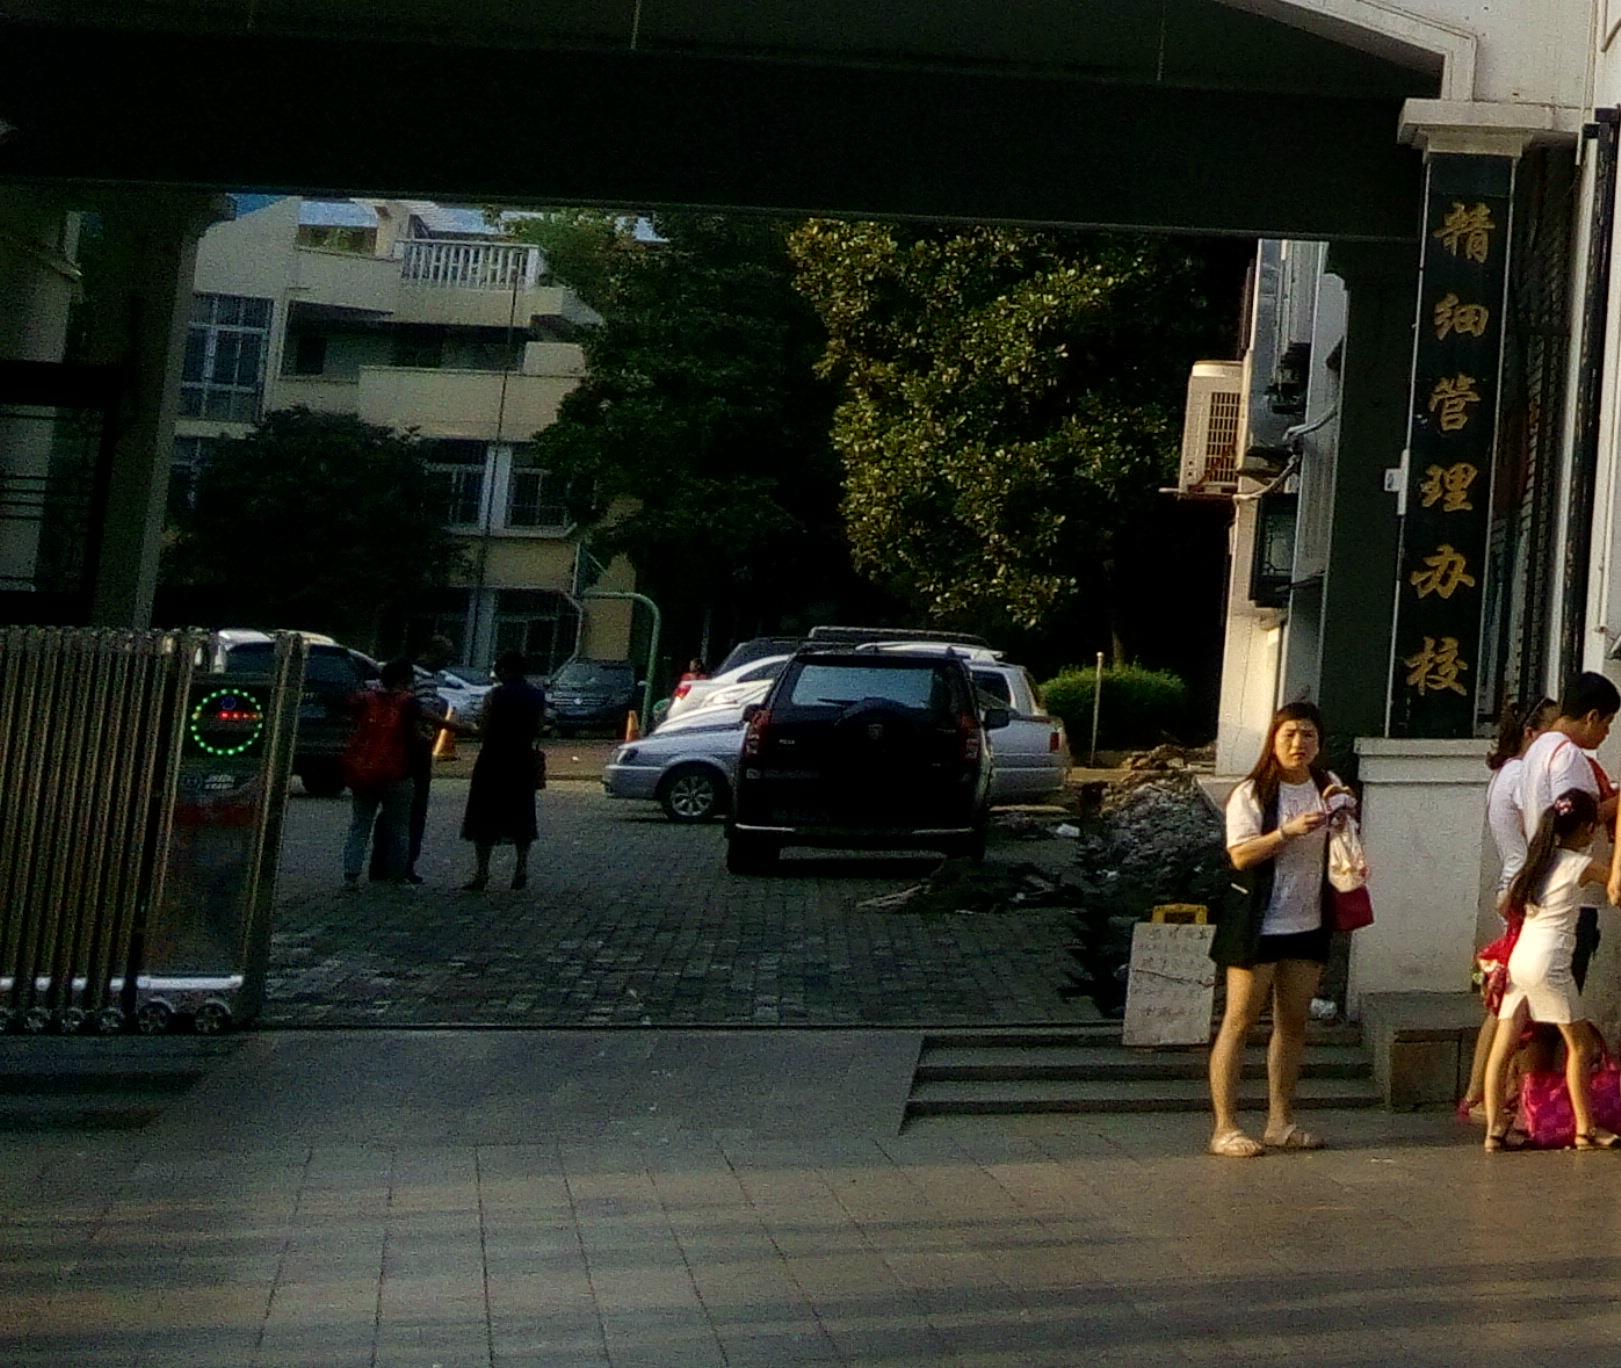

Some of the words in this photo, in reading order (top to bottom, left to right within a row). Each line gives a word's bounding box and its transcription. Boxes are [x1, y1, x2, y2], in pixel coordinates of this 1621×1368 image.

[1403, 201, 1497, 697] 精细管理办校
